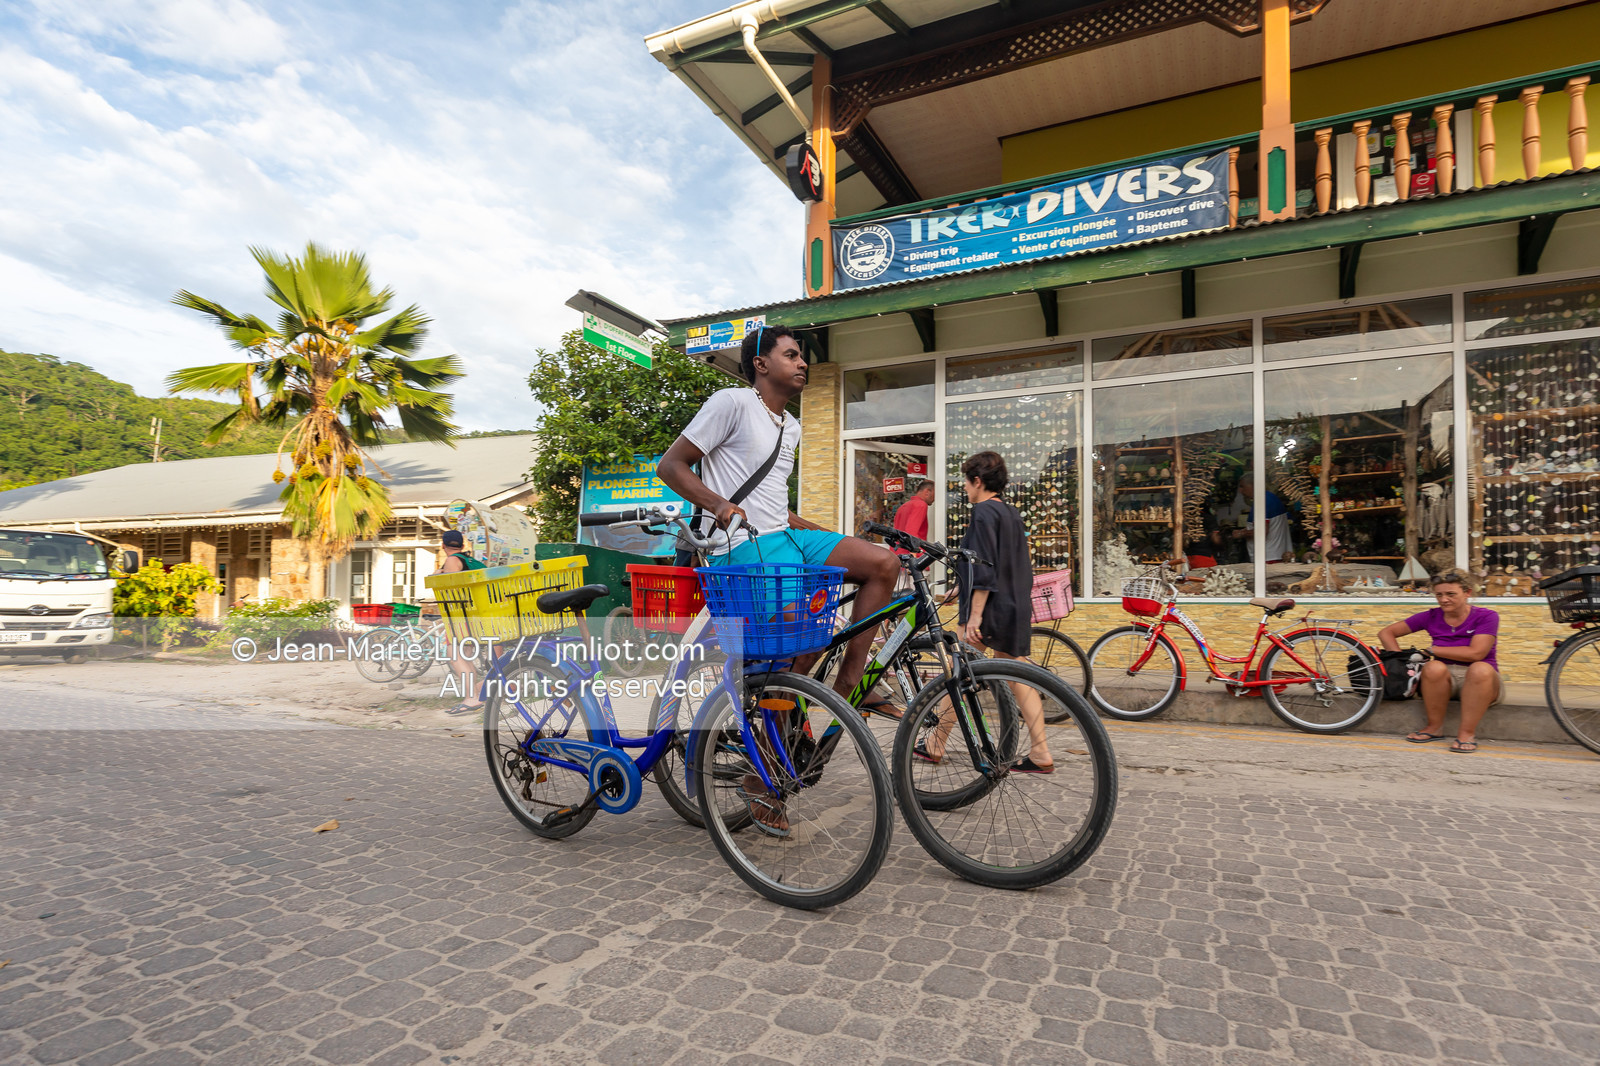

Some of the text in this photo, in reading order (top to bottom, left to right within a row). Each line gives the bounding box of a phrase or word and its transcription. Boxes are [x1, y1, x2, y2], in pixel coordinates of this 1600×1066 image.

[906, 156, 1215, 244] TREK DIVERS
[1136, 199, 1215, 221] Discover dive
[1018, 217, 1117, 242] Excursion plongée
[1136, 217, 1189, 235] Bapteme
[909, 246, 959, 261] Diving trip
[1019, 243, 1049, 255] Vente
[909, 251, 1000, 274] Equipment retailer
[745, 316, 764, 330] Ria
[604, 340, 617, 353] 1st
[617, 346, 637, 361] Floor
[592, 462, 658, 475] SCUBA DIV
[587, 477, 649, 490] PLONGEE
[886, 484, 903, 492] OPEN
[611, 487, 663, 500] MARINE
